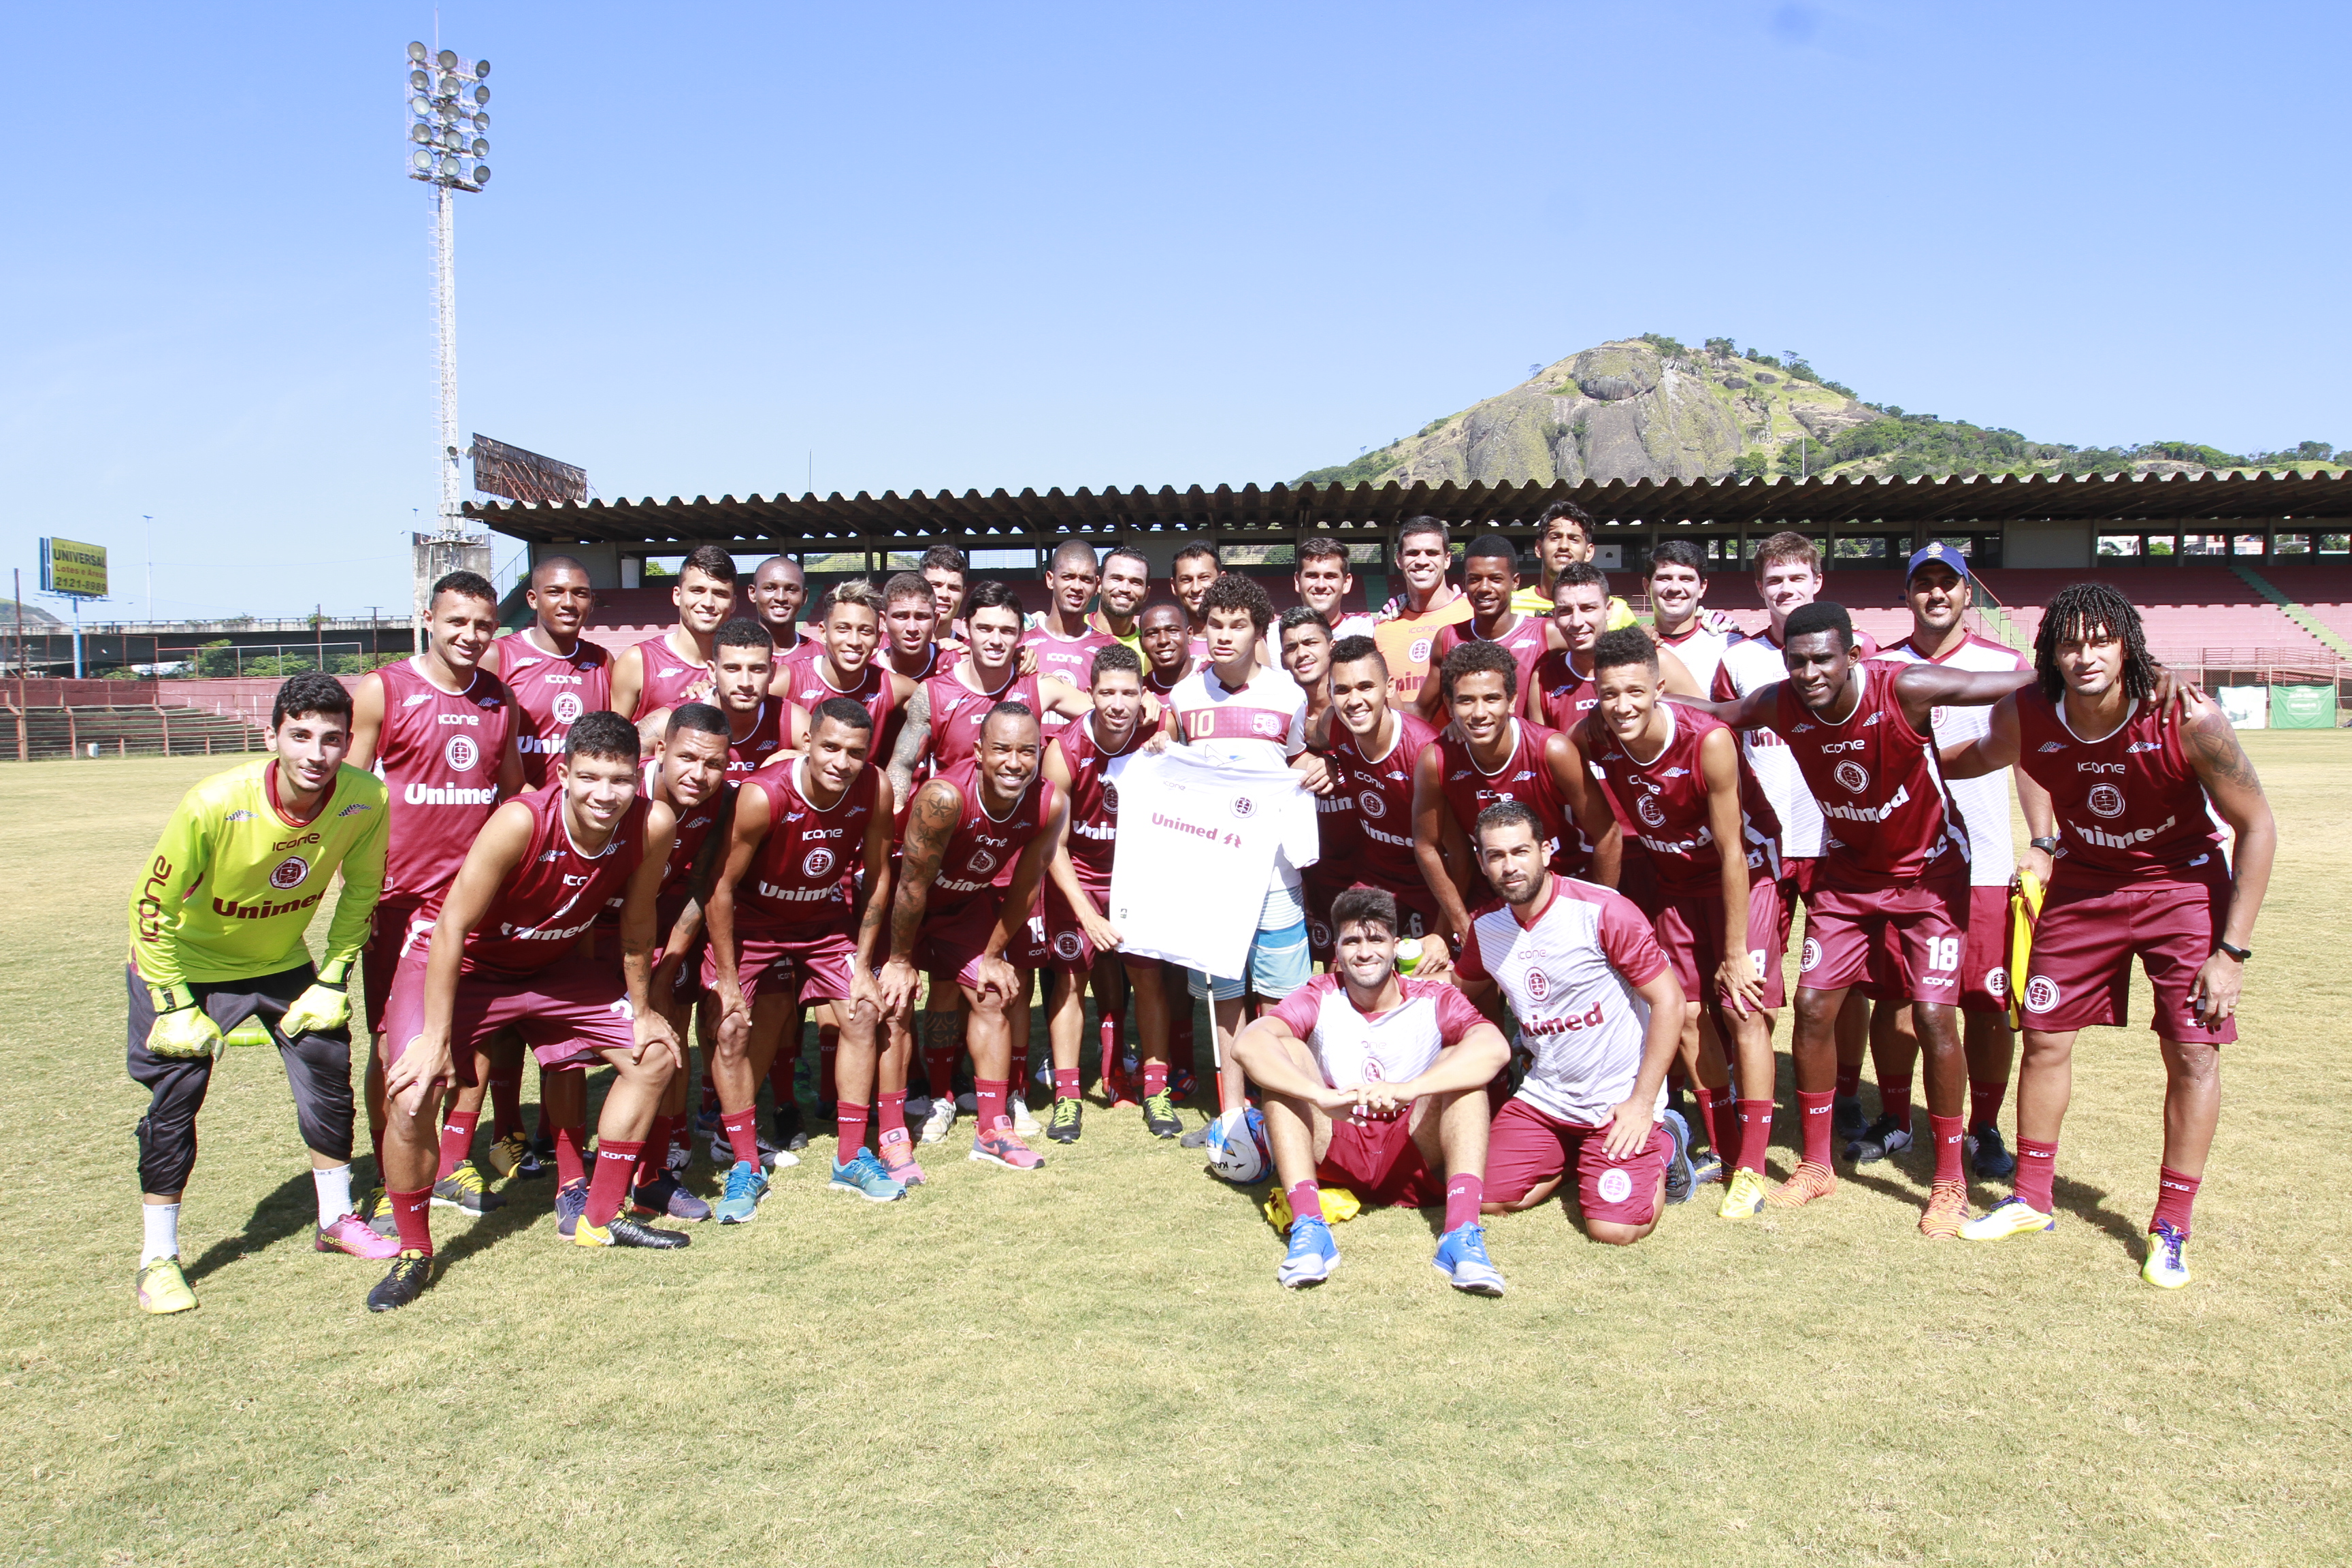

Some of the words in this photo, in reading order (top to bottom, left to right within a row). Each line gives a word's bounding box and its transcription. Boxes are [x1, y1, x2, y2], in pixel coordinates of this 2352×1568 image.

[53, 549, 107, 569] UNIVERSAL
[56, 564, 79, 574] Lotes
[1190, 710, 1215, 738] 10
[517, 734, 566, 753] Uni
[1751, 730, 1787, 747] Uni
[1315, 794, 1356, 813] nim
[1816, 784, 1910, 823] Unimed
[1072, 819, 1116, 840] Uni
[1152, 813, 1218, 840] Unimed
[1639, 826, 1712, 854] nimed
[1926, 936, 1959, 971] 18
[1522, 1001, 1604, 1038] nimed
